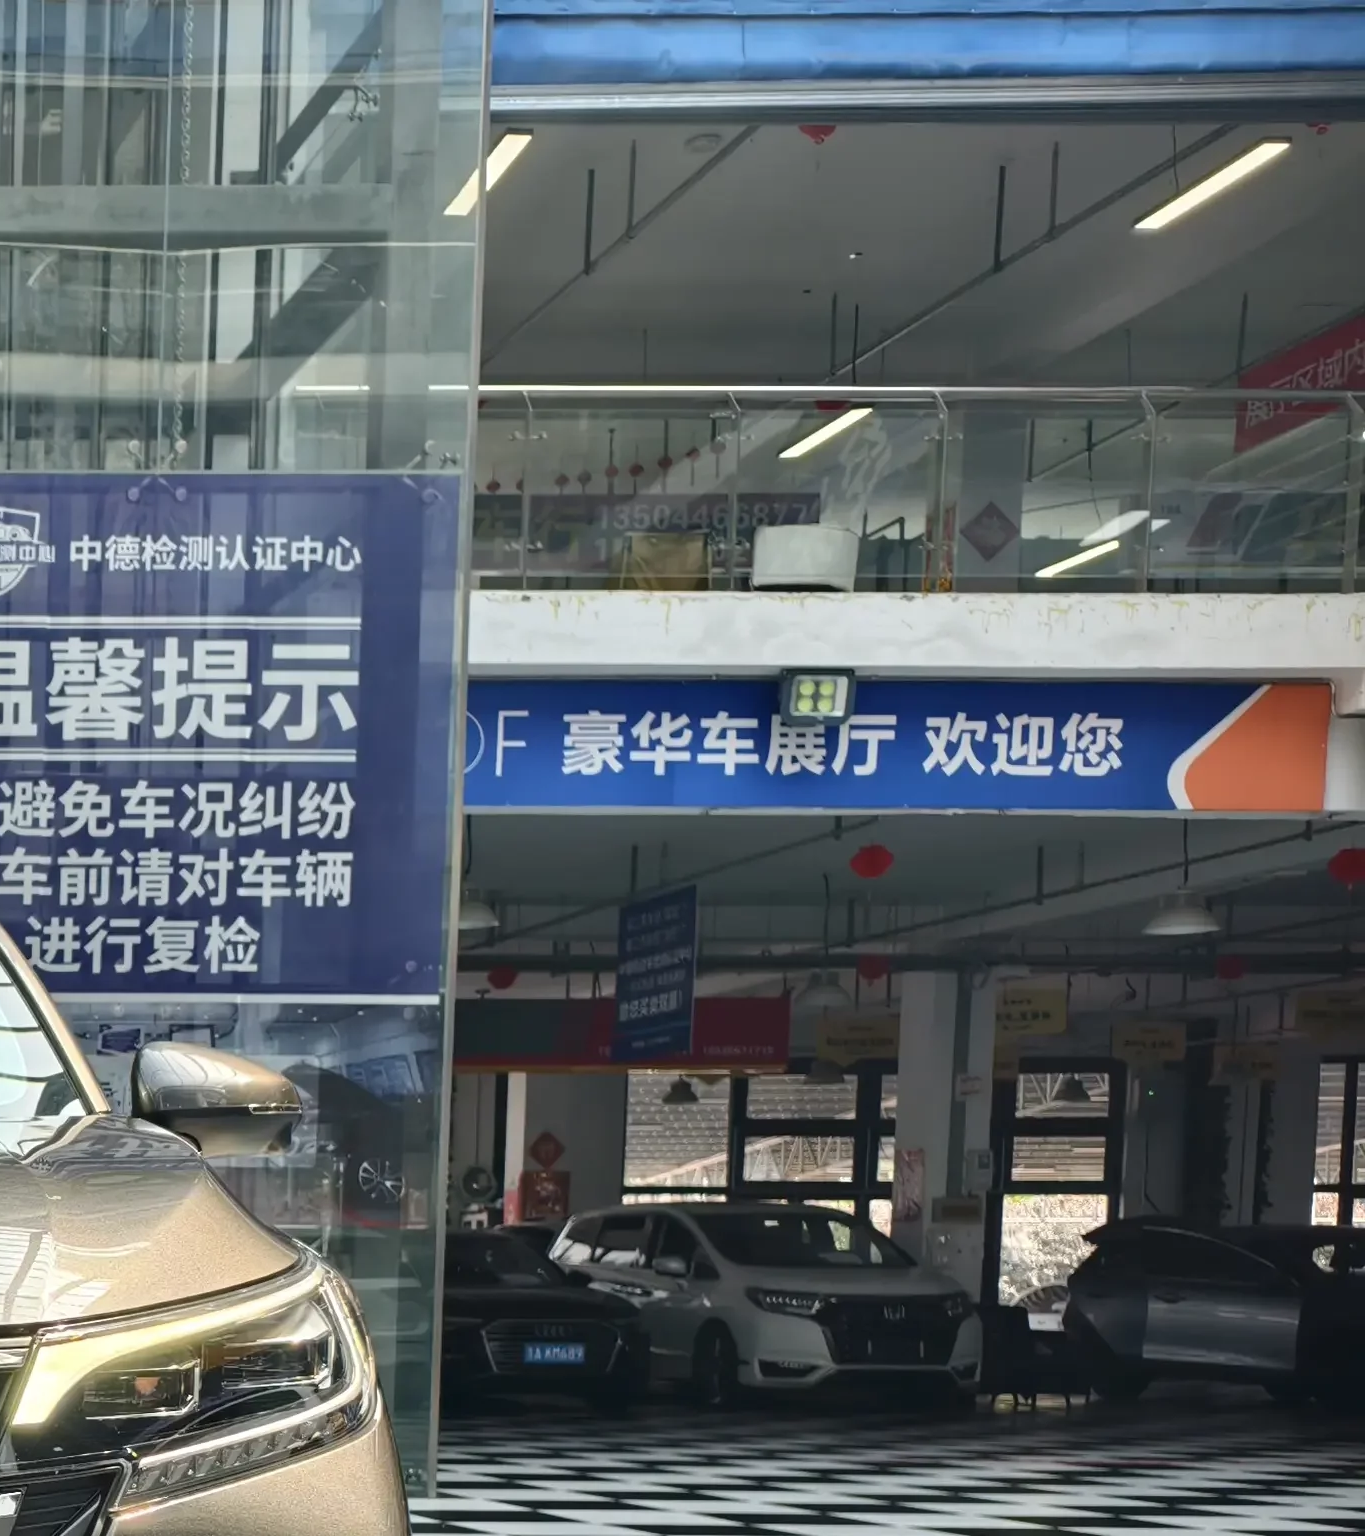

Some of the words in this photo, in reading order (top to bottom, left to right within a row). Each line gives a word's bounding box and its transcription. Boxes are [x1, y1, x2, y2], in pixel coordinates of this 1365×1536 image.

[69, 535, 362, 572] 中德检测认证中心
[560, 711, 897, 777] 豪华车展厅
[923, 711, 1126, 777] 欢迎您
[24, 916, 261, 975] 进行复检
